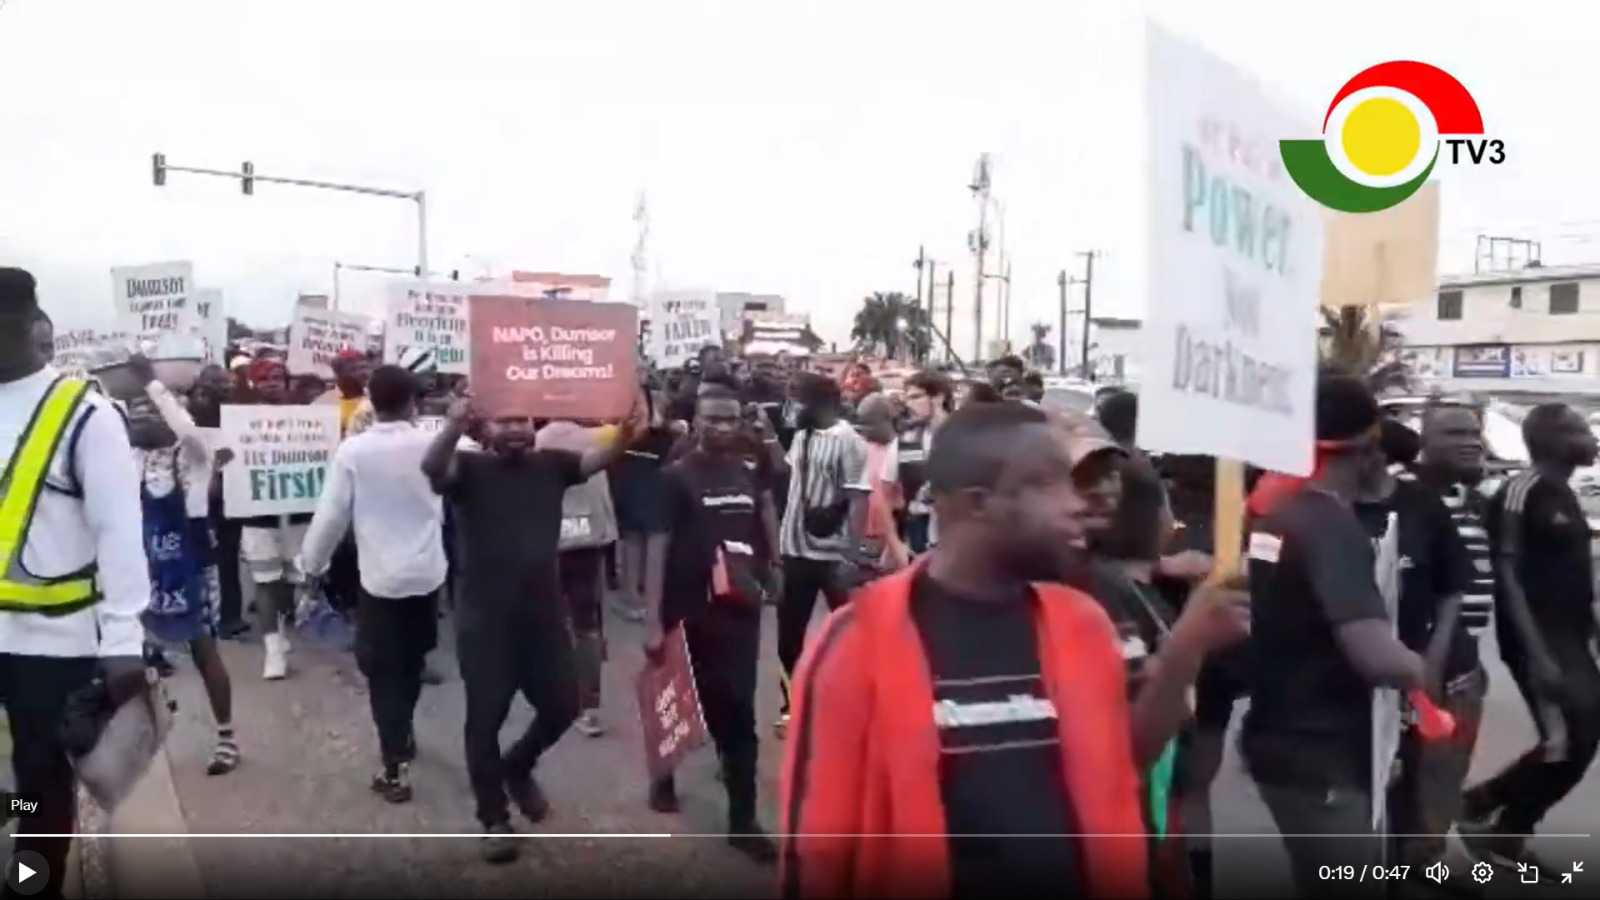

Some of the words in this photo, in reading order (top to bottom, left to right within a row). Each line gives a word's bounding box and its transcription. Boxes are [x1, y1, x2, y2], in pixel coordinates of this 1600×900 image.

[492, 326, 549, 345] NAPO,
[550, 327, 616, 342] Dumsor
[540, 344, 593, 366] Killing
[505, 366, 539, 380] Our
[542, 364, 614, 379] Dreams!
